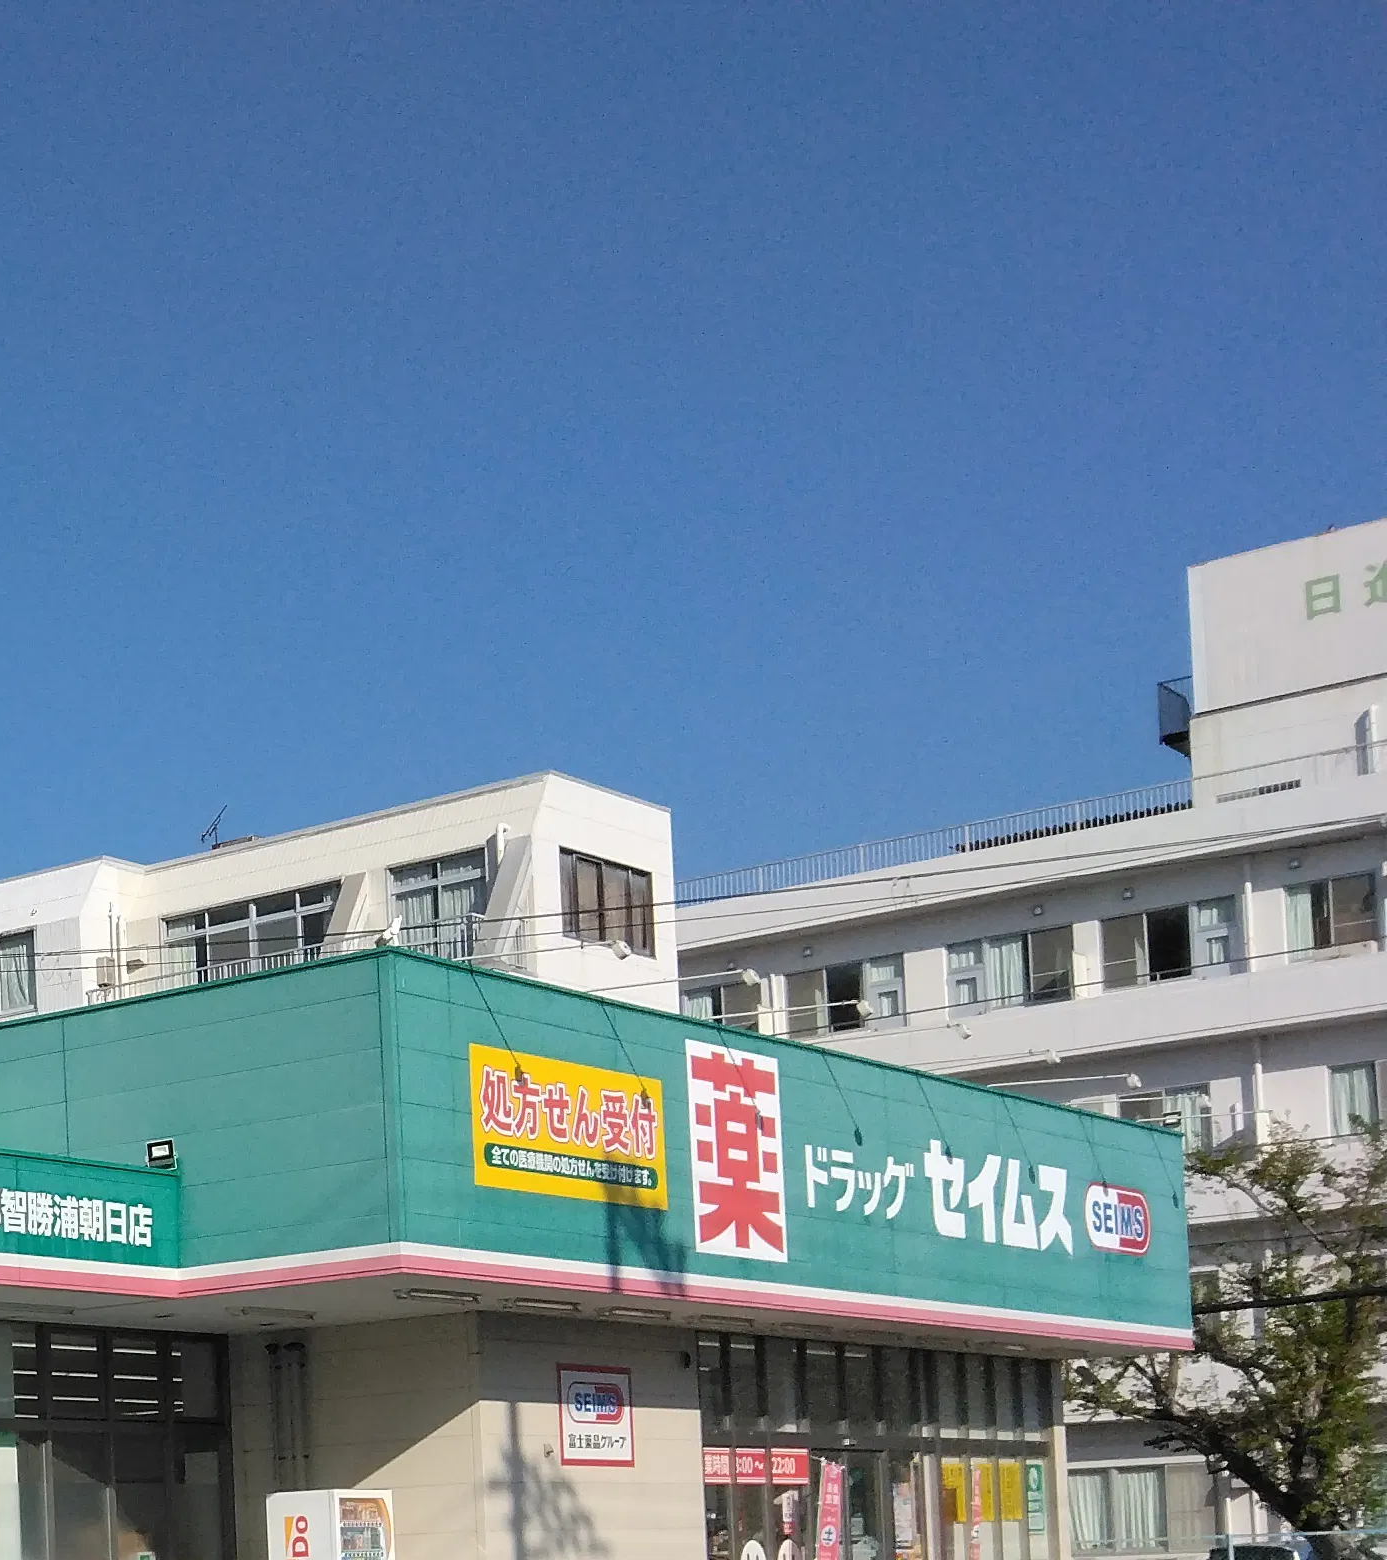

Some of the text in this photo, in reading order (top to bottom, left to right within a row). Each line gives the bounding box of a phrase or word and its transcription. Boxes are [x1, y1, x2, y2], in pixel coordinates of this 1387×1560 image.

[480, 1065, 657, 1159] 処方せん受付
[691, 1050, 784, 1254] 薬
[804, 1139, 1074, 1256] ドラッグ セイムス
[1091, 1200, 1144, 1239] SEIMS
[574, 1392, 617, 1413] SEIMS
[568, 1433, 626, 1449] 富士薬品グループ
